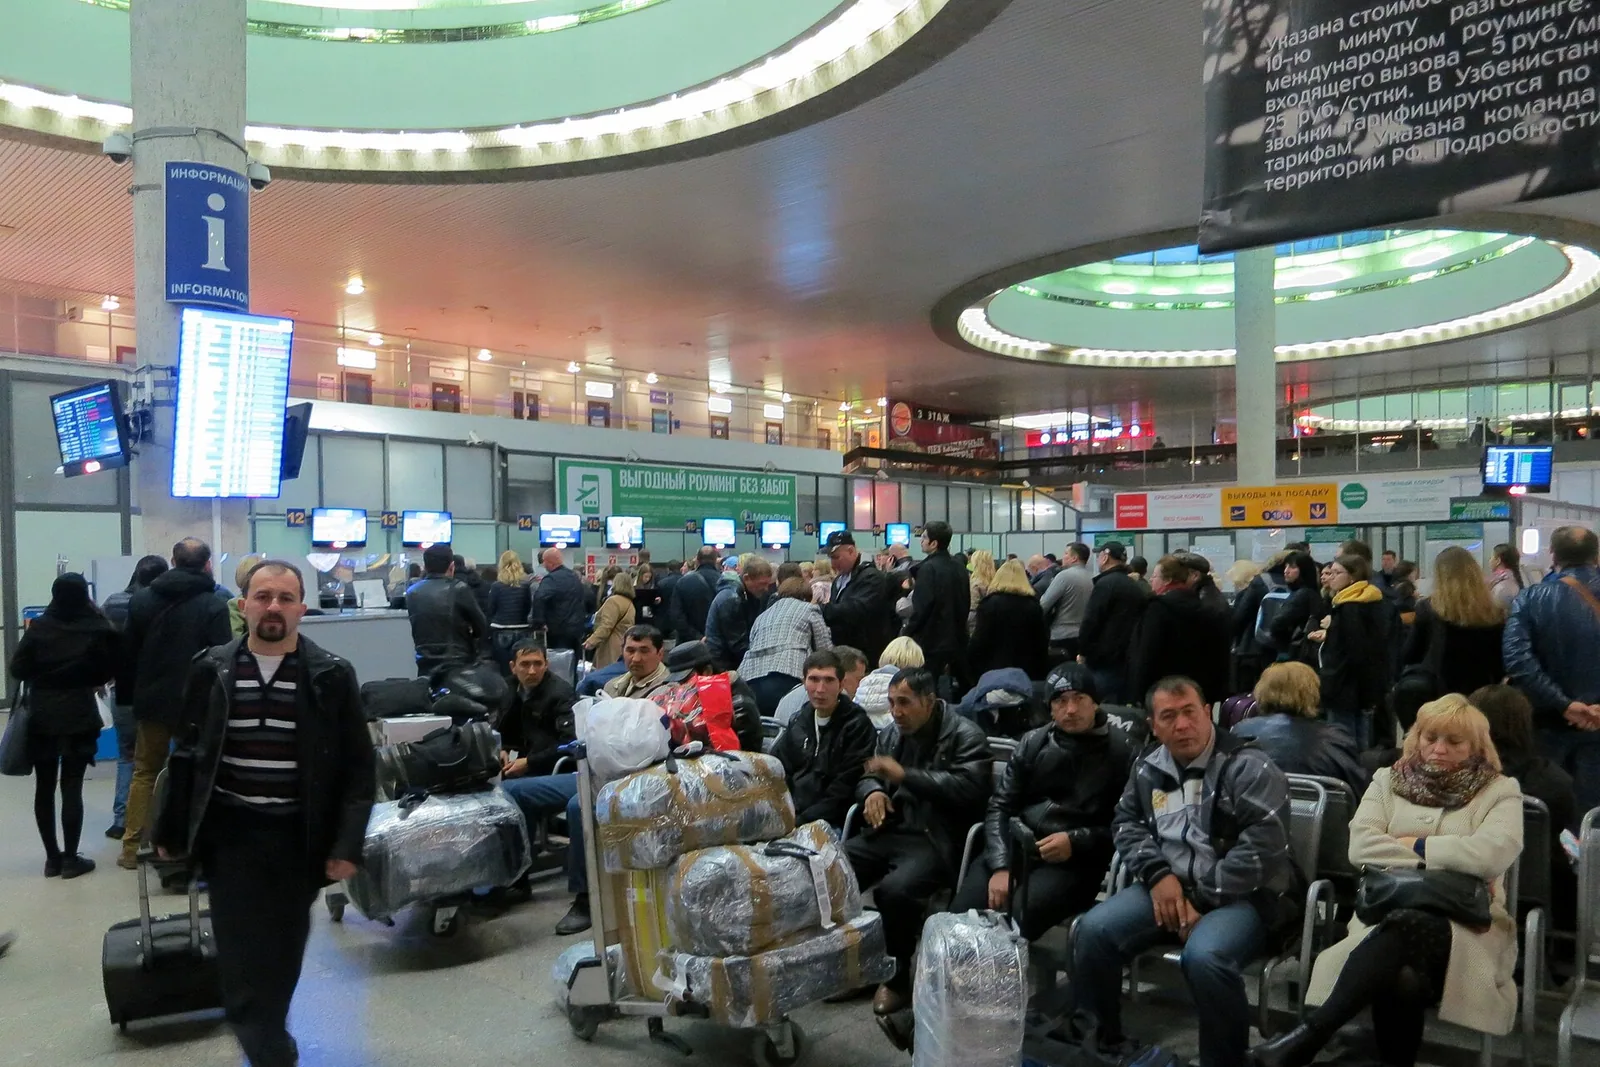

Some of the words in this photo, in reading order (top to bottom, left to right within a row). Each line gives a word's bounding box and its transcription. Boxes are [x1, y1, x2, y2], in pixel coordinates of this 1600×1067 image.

[1266, 32, 1446, 93] международном
[1462, 0, 1590, 45] роуминге.
[1339, 17, 1418, 52] минуту
[1266, 72, 1375, 113] входящего
[1380, 51, 1460, 84] вызова
[1492, 34, 1506, 55] 5
[1264, 114, 1287, 134] 25
[1428, 74, 1442, 93] В
[1265, 124, 1332, 154] звонки
[1342, 75, 1542, 133] тарифицируются
[1558, 64, 1591, 86] по
[1264, 141, 1352, 173] тарифам
[1373, 116, 1465, 148] Указана
[1484, 87, 1595, 125] команда
[1264, 154, 1385, 192] территории
[928, 410, 950, 423] ЭТАЖ
[620, 469, 687, 491] ВЫГОДНЫЙ
[689, 473, 738, 493] РОУМИНГ
[740, 476, 759, 494] БЕЗ
[760, 478, 790, 496] ЗАБОТ
[1227, 490, 1267, 500] ВЫХОДЫ
[1285, 488, 1330, 498] ПОСАДКУ
[288, 512, 305, 525] 12
[381, 515, 397, 526] 13
[519, 517, 532, 528] 14
[587, 519, 599, 530] 15
[745, 523, 755, 532] 17
